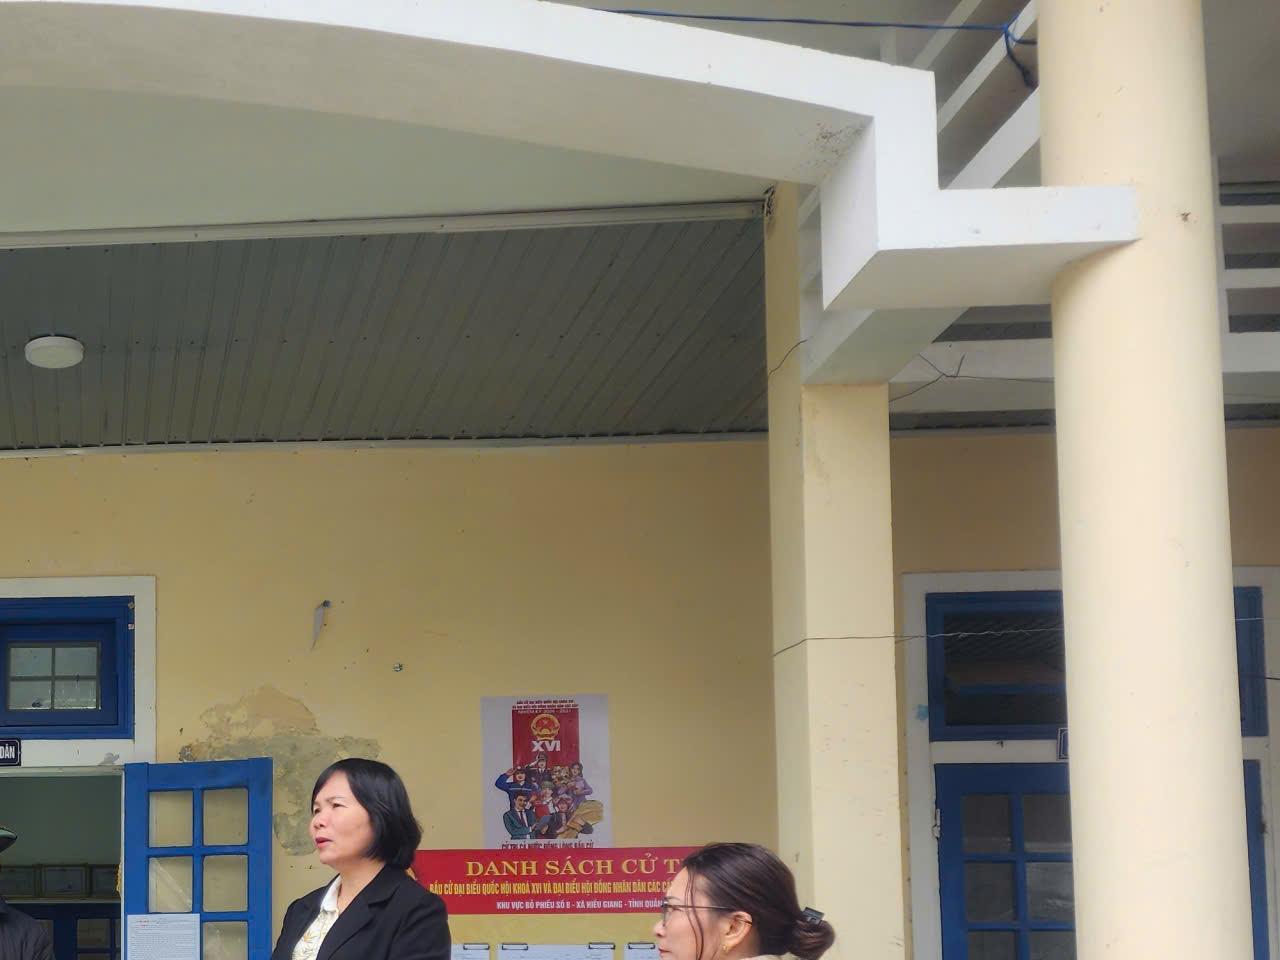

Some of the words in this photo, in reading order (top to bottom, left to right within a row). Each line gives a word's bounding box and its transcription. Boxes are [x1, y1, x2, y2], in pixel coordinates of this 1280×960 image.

[0, 743, 15, 759] DÂN
[532, 740, 560, 752] XVI
[466, 861, 538, 875] DANH
[545, 856, 614, 875] SÁCH
[621, 852, 658, 874] CỬ
[531, 883, 542, 894] XVI
[496, 901, 510, 909] KHU
[603, 900, 623, 908] GIANG
[645, 899, 663, 908] QUẢN
